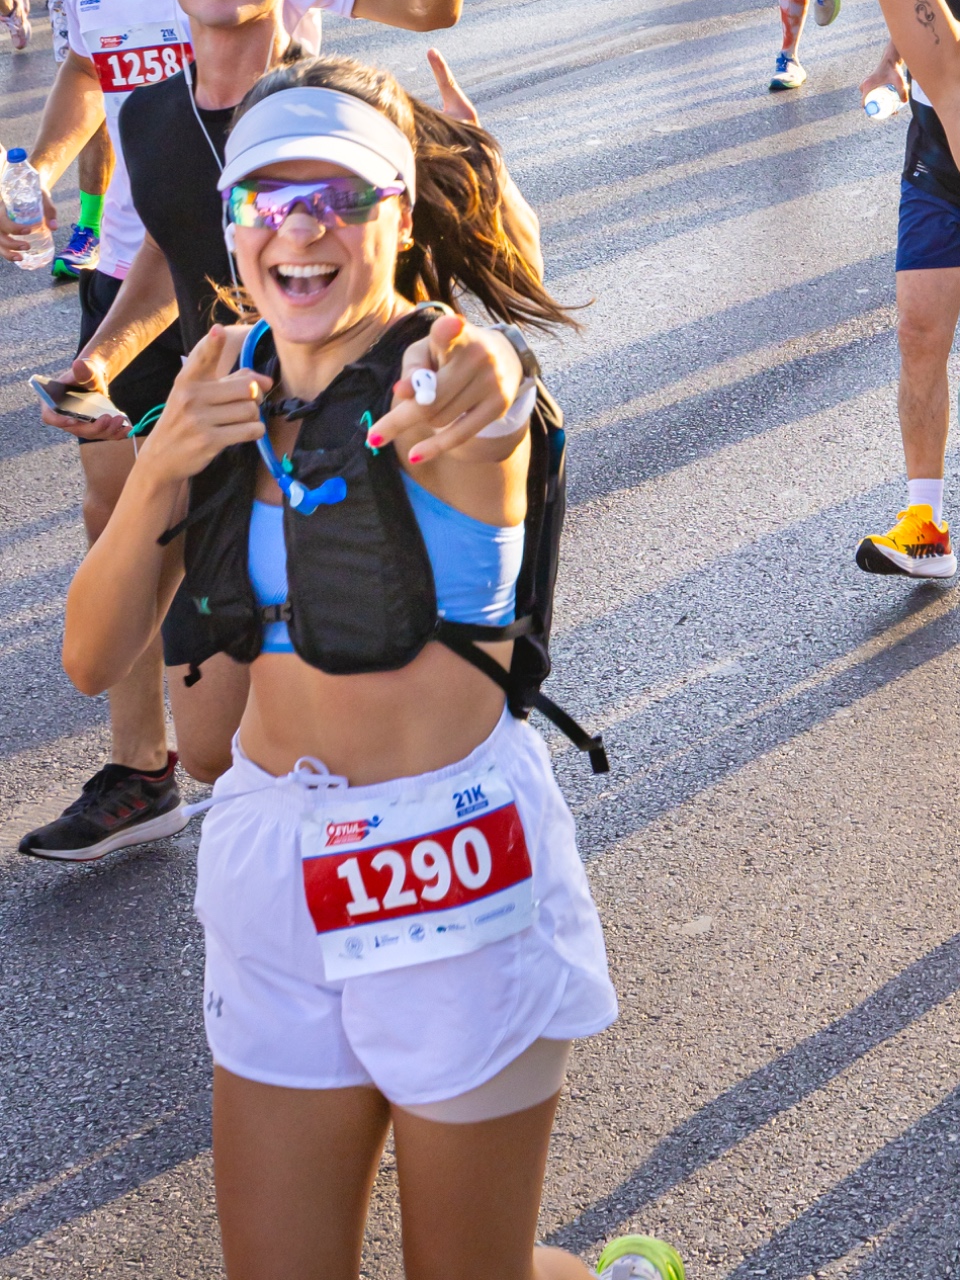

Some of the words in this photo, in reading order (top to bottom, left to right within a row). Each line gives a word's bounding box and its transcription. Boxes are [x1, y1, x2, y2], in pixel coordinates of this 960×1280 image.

[160, 28, 176, 38] 21K
[107, 47, 182, 87] 1258
[901, 542, 945, 560] NITRO
[452, 783, 486, 809] 21K
[337, 826, 493, 917] 1290
